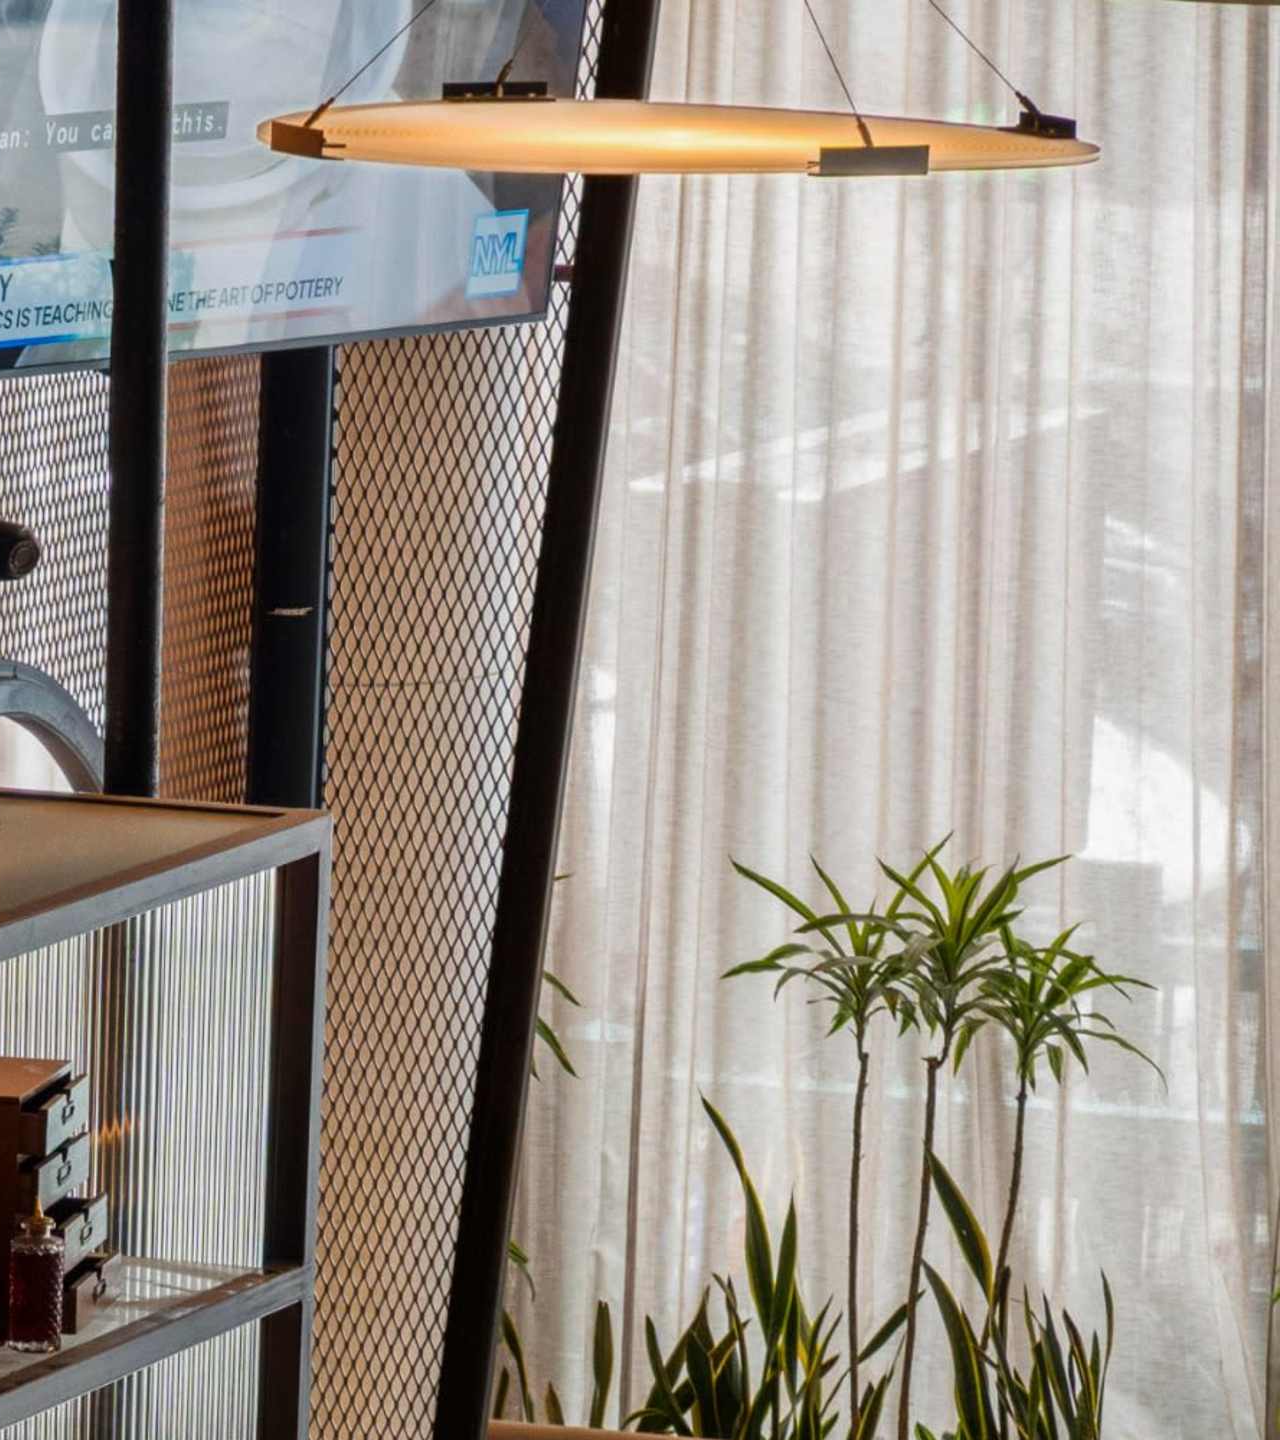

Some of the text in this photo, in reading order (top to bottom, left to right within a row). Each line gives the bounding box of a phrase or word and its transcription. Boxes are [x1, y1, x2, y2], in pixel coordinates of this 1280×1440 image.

[45, 121, 79, 145] You
[172, 112, 225, 136] this.
[16, 307, 31, 329] IS
[33, 300, 114, 328] TEACHING
[186, 286, 217, 310] THE
[218, 284, 250, 308] ART
[251, 282, 274, 306] OF
[275, 276, 344, 303] POTTERY
